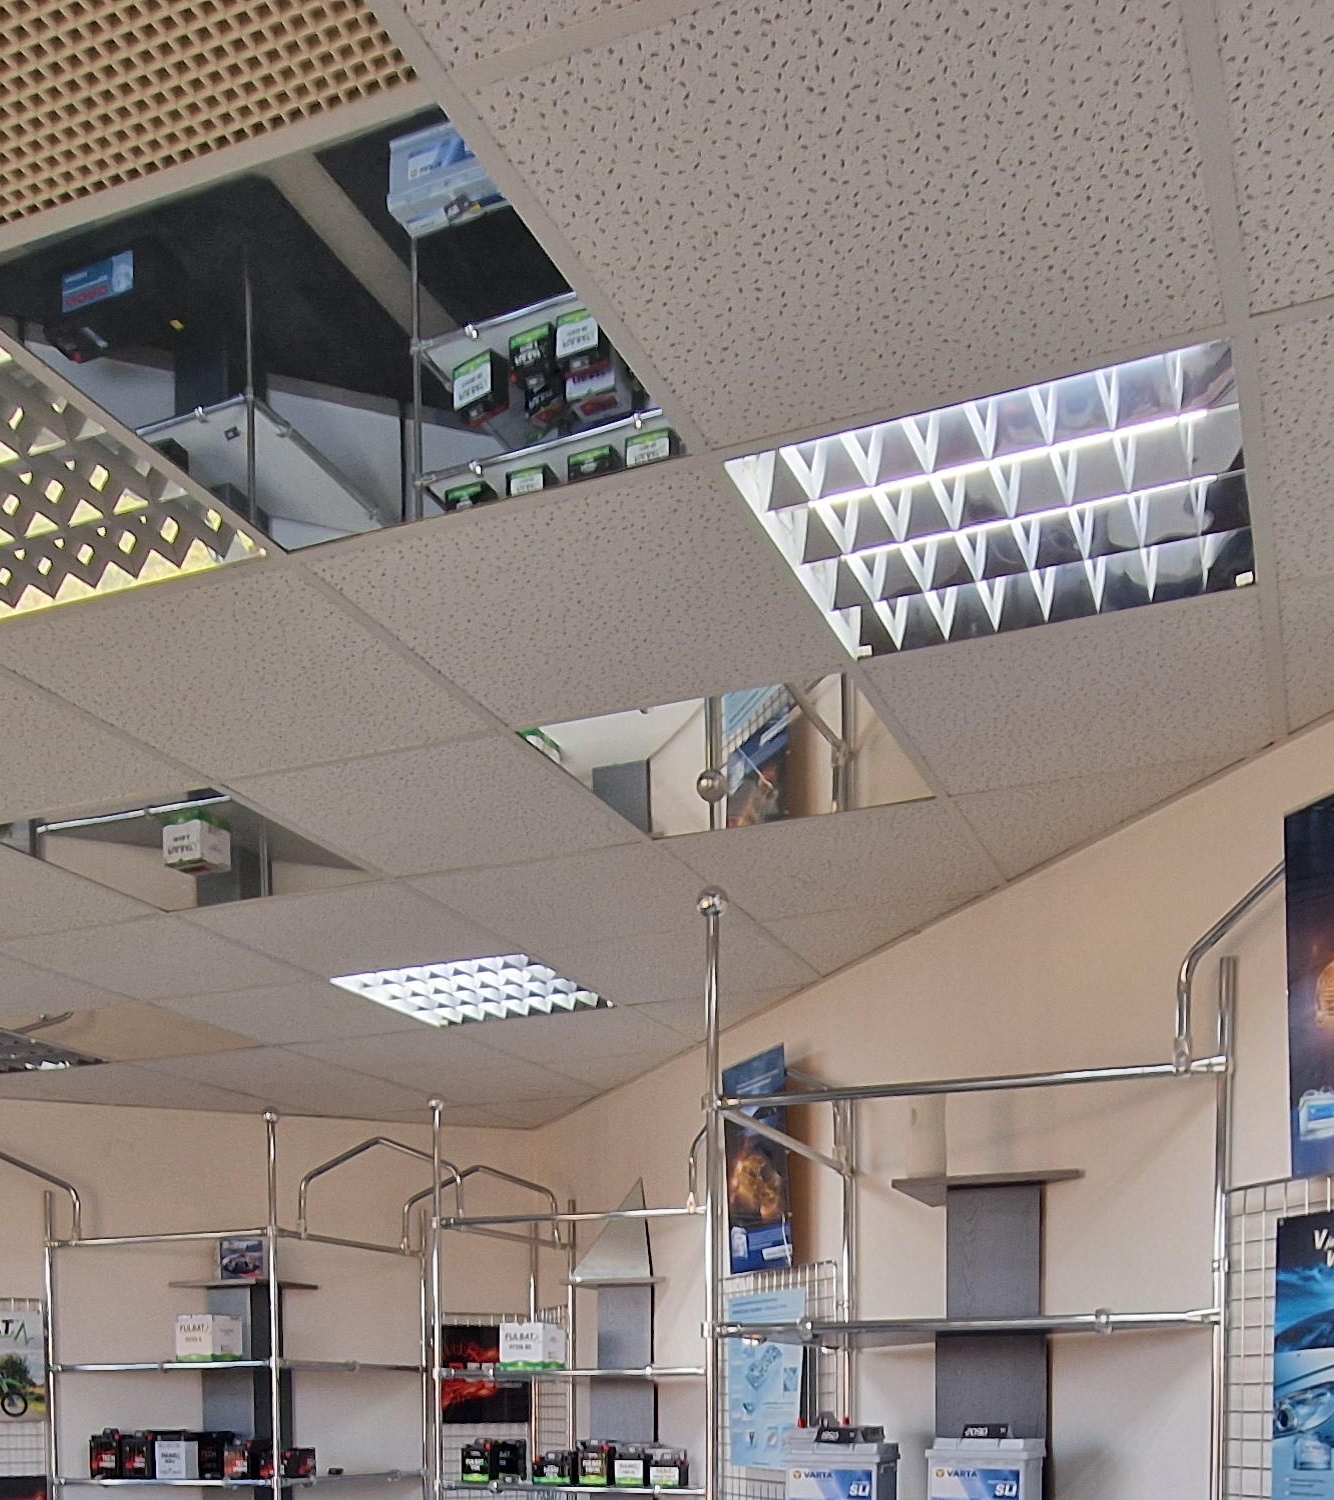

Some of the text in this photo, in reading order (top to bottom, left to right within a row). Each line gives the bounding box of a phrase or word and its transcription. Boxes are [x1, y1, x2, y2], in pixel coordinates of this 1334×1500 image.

[1314, 1229, 1328, 1250] V
[505, 1332, 535, 1341] FULBAT
[803, 1469, 833, 1480] VARTA
[946, 1468, 978, 1479] VARTA
[848, 1482, 871, 1498] SLI
[994, 1482, 1018, 1498] SLI
